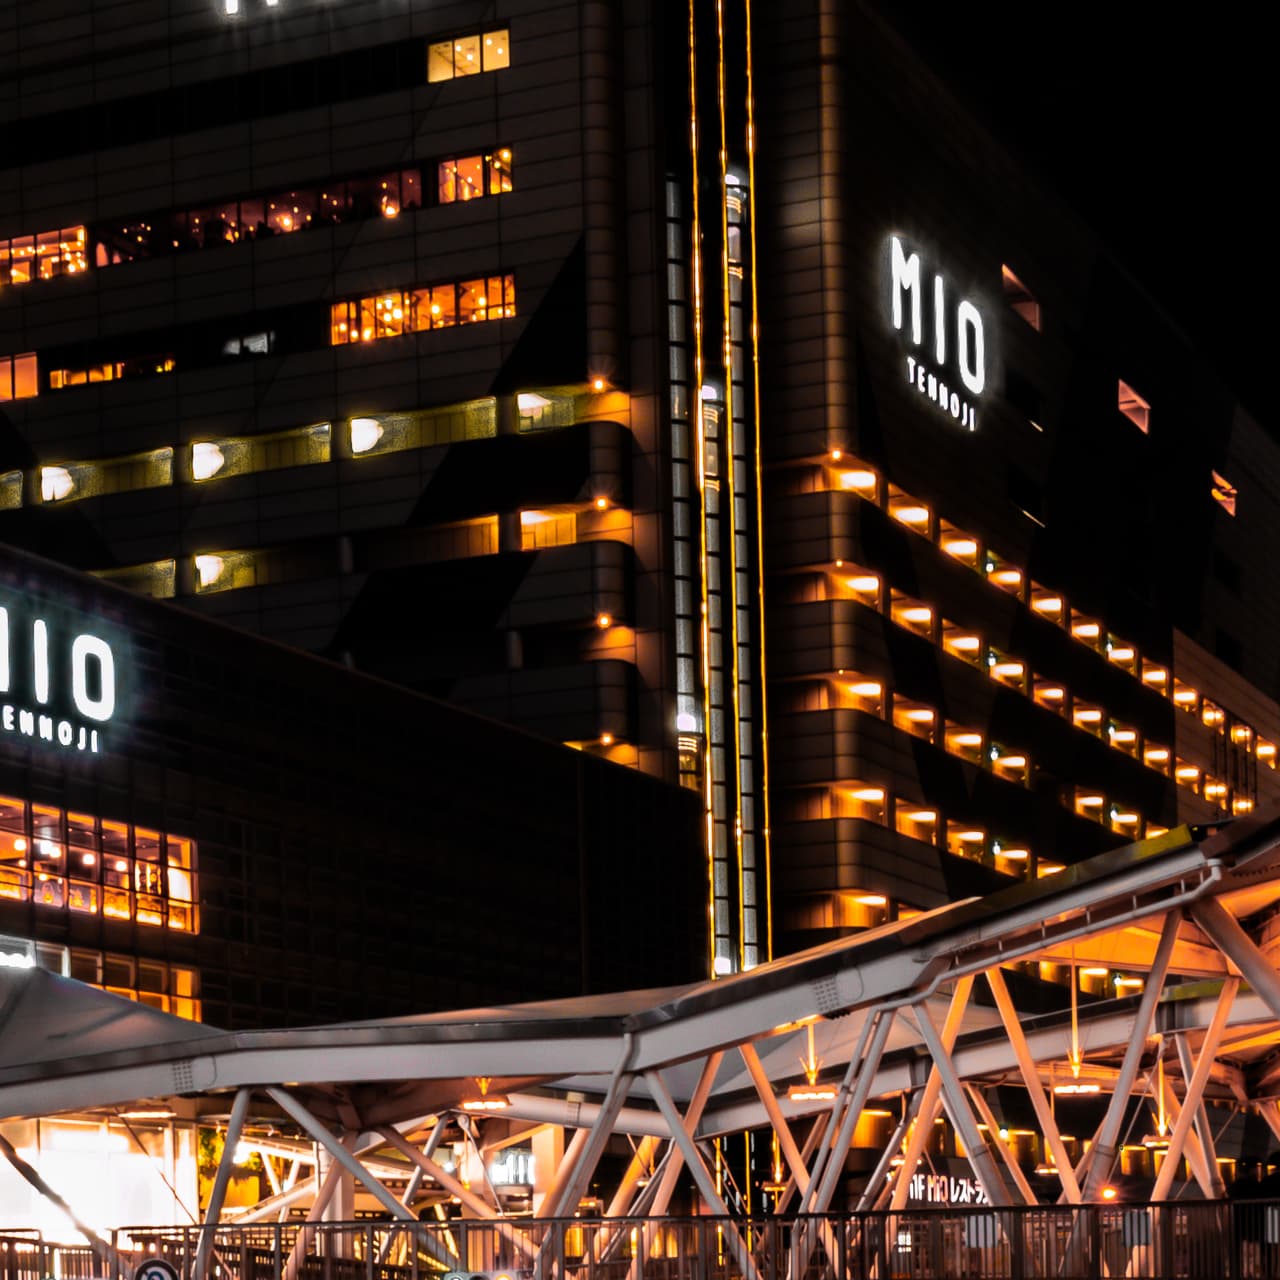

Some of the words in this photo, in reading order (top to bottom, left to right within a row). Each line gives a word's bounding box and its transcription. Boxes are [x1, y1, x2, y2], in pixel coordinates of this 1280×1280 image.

[891, 236, 985, 394] MIO
[907, 356, 976, 432] TENNOJI
[950, 1176, 990, 1205] レストラ
